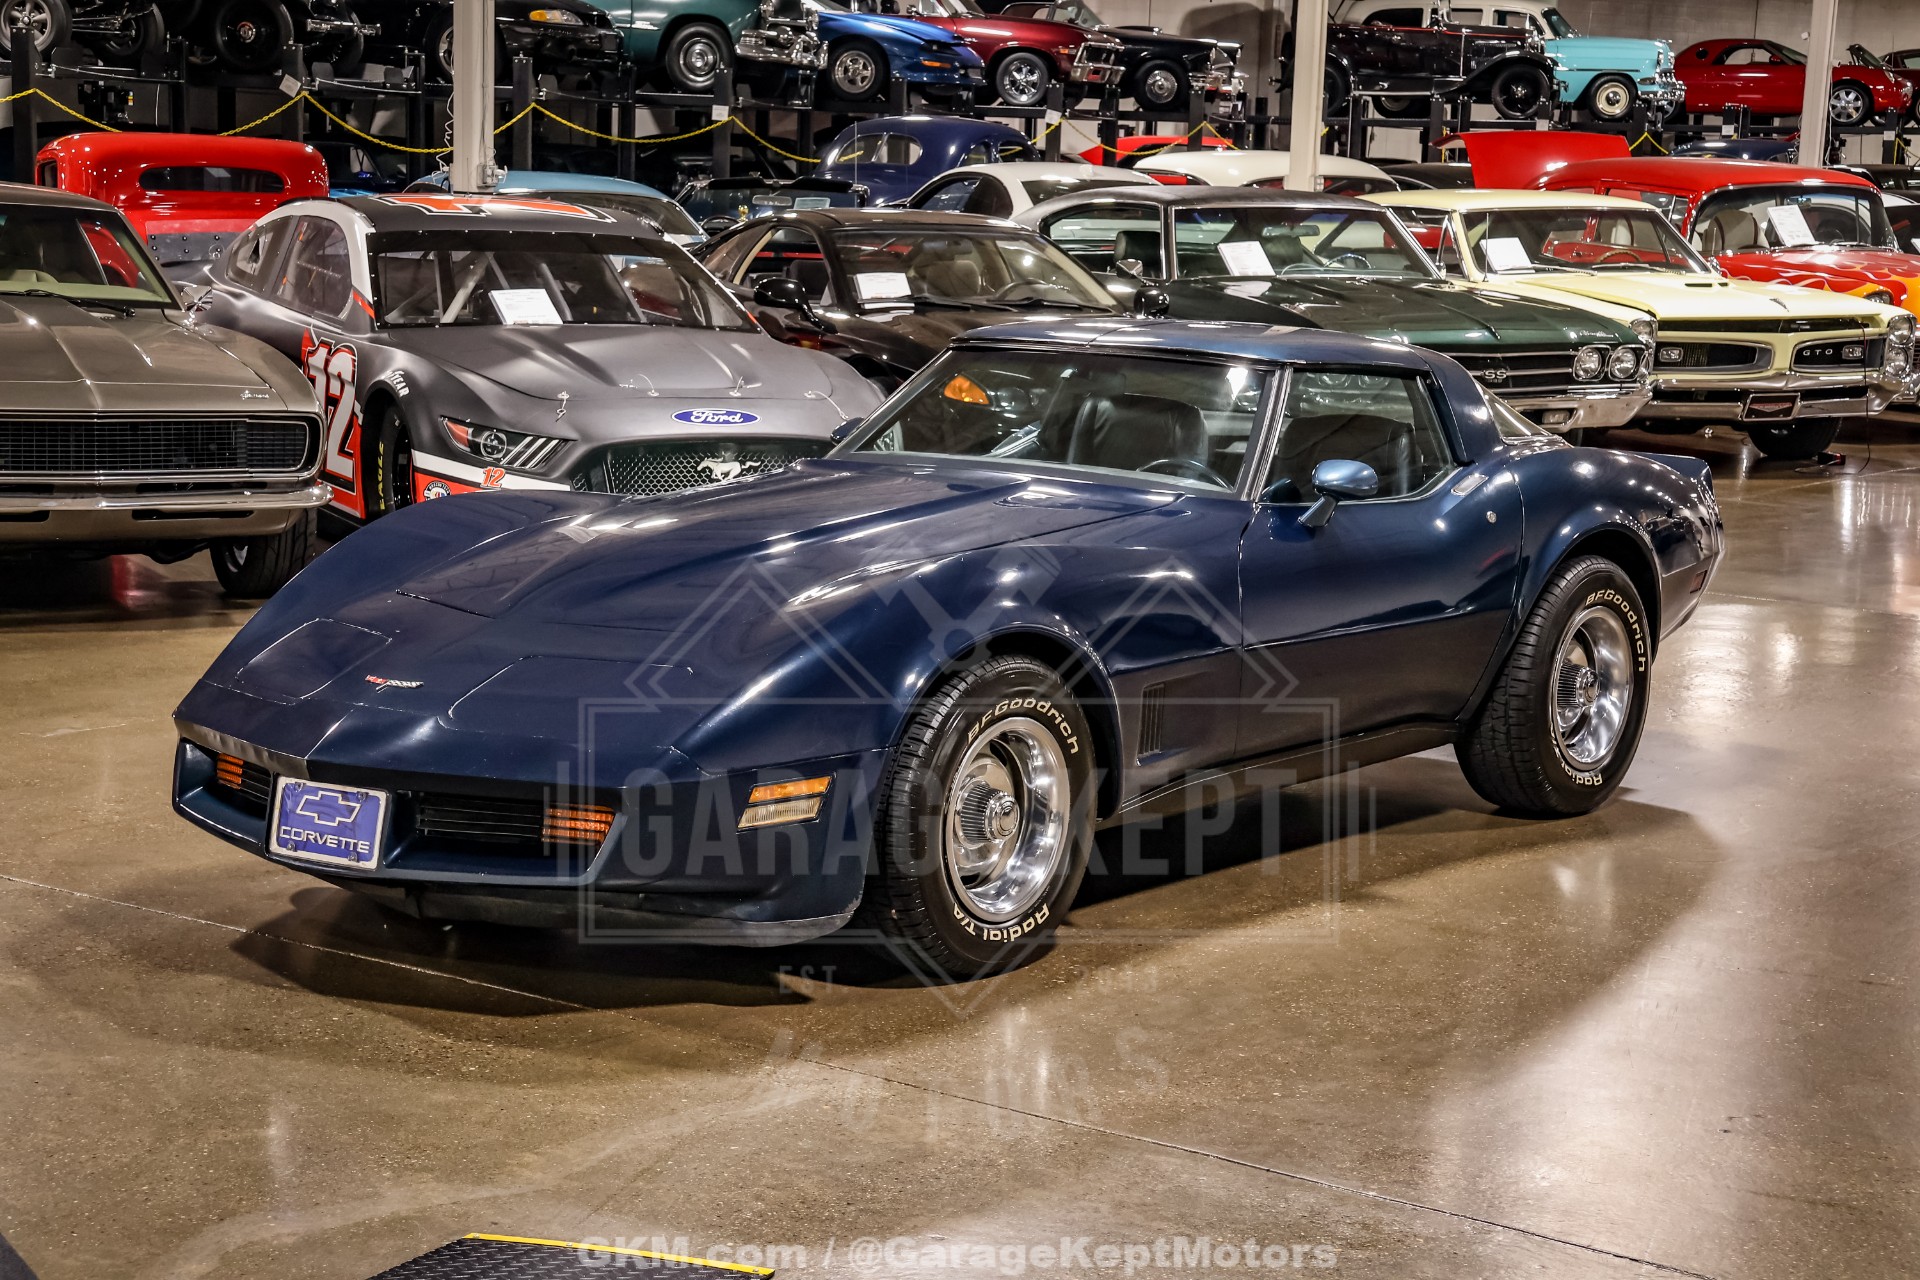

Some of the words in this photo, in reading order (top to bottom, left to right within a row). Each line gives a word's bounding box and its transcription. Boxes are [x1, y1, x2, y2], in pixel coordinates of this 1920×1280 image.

[1802, 348, 1833, 356] GTO
[1484, 369, 1507, 379] SS
[690, 410, 744, 423] Ford
[481, 466, 506, 488] 12
[1585, 588, 1646, 672] BFGoodrich
[967, 697, 1079, 754] BFGoodrich
[280, 826, 371, 854] CORVETTE
[953, 902, 976, 936] T/A
[983, 903, 1050, 943] Radial
